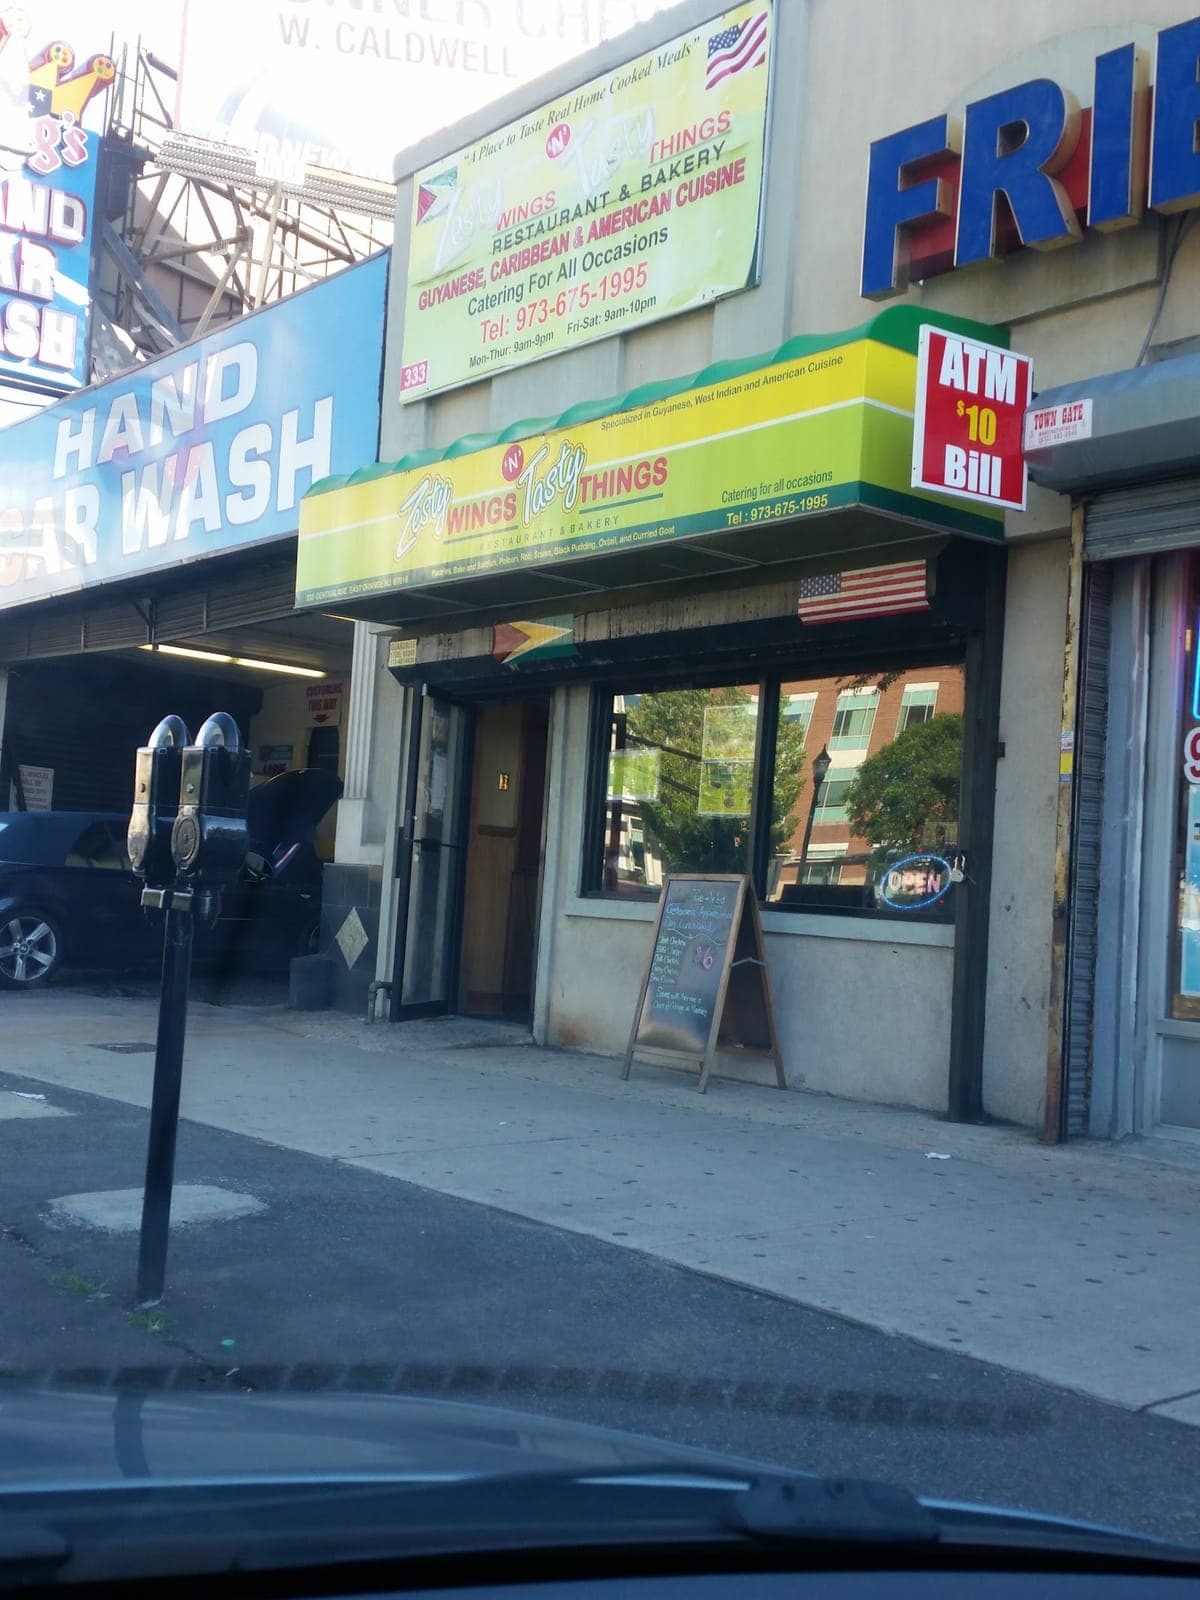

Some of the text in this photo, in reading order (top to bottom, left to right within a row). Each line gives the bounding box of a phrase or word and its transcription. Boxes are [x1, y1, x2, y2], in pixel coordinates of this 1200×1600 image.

[277, 12, 320, 50] W.
[336, 21, 518, 78] CALDWELL
[479, 138, 502, 161] Place
[506, 133, 516, 148] to
[520, 119, 544, 139] Taste
[548, 104, 571, 126] Real
[574, 87, 606, 113] Home
[609, 60, 652, 94] Cooked
[650, 110, 731, 164] THINGS
[493, 140, 725, 255] RESTAURANT & BAKERY
[496, 190, 556, 231] WINGS
[418, 157, 746, 311] GUYANESE, CARIBBEAN & AMERICAN CUISINE
[468, 226, 668, 316] Catering For All Occasions
[480, 261, 648, 344] Tel: 973-675-1995
[469, 296, 657, 369] Mon-Thur: 9am-9pm Fri-Sat: 9am-10pm
[404, 363, 426, 387] 333
[600, 355, 843, 432] Specialized in Guyanese, West Indian and American Cuisine
[939, 337, 1017, 406] ATM
[53, 342, 258, 480] HAND
[956, 400, 997, 446] $10
[1034, 409, 1057, 431] TOWN
[1062, 403, 1083, 424] GATE
[121, 396, 333, 556] WASH
[396, 439, 668, 561] Zesty WINGS Tasty THINGS
[721, 471, 832, 504] Catering for all occasions
[944, 443, 1002, 498] Bill
[480, 515, 619, 550] RESTAURANT & BAKERY
[572, 541, 597, 554] Pudding,
[619, 534, 632, 544] and
[633, 529, 658, 541] Curried
[659, 525, 675, 536] Goat
[750, 494, 829, 521] 973-675-1995
[888, 869, 941, 896] OPEN
